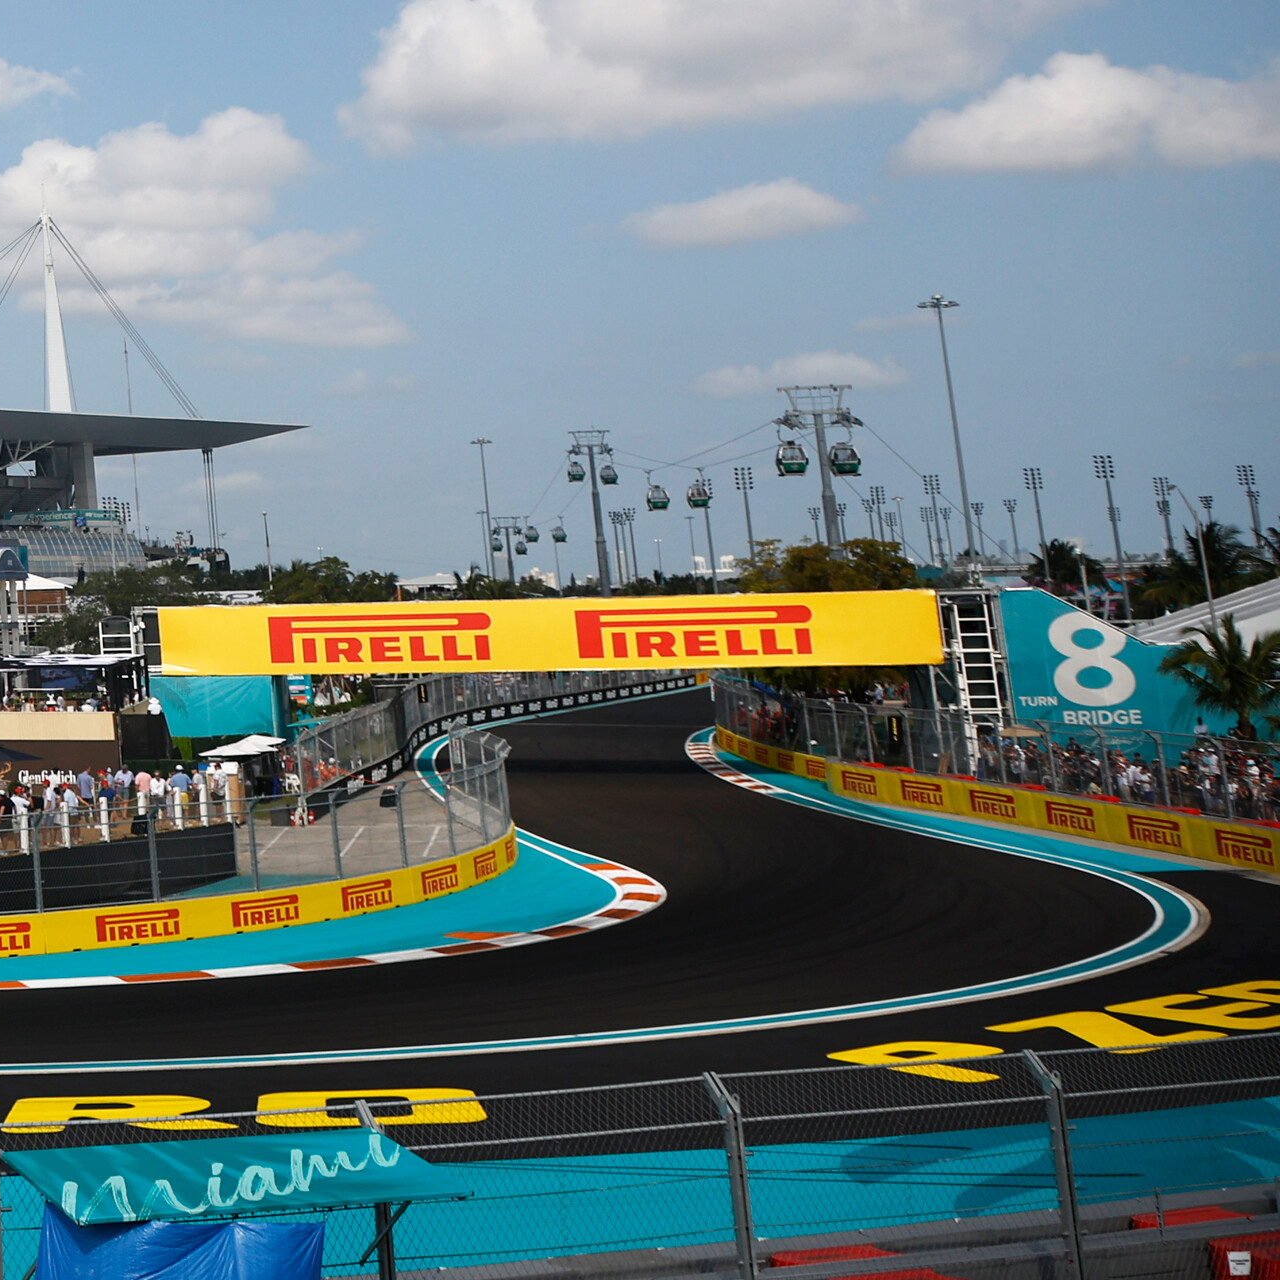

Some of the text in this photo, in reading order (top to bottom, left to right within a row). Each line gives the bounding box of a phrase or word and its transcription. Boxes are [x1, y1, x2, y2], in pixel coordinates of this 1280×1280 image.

[268, 605, 813, 664] PIRELLI PIRELLI
[1018, 610, 1137, 708] TURN 8
[1063, 709, 1143, 725] BRIDGE
[18, 769, 77, 785] Glenfiich
[842, 771, 877, 796] PIRELLI
[902, 780, 944, 806] PIRELLI
[969, 789, 1016, 819] PIRELLI
[1046, 800, 1096, 832] PIRELLI
[1128, 814, 1182, 848] PIRELLI
[1215, 829, 1274, 866] PIRELLI
[342, 879, 392, 911] PIRELLI
[421, 864, 458, 895] PIRELLI
[96, 908, 179, 942] PIRELLI
[232, 895, 299, 927] PIRELLI
[827, 1041, 1004, 1083] P
